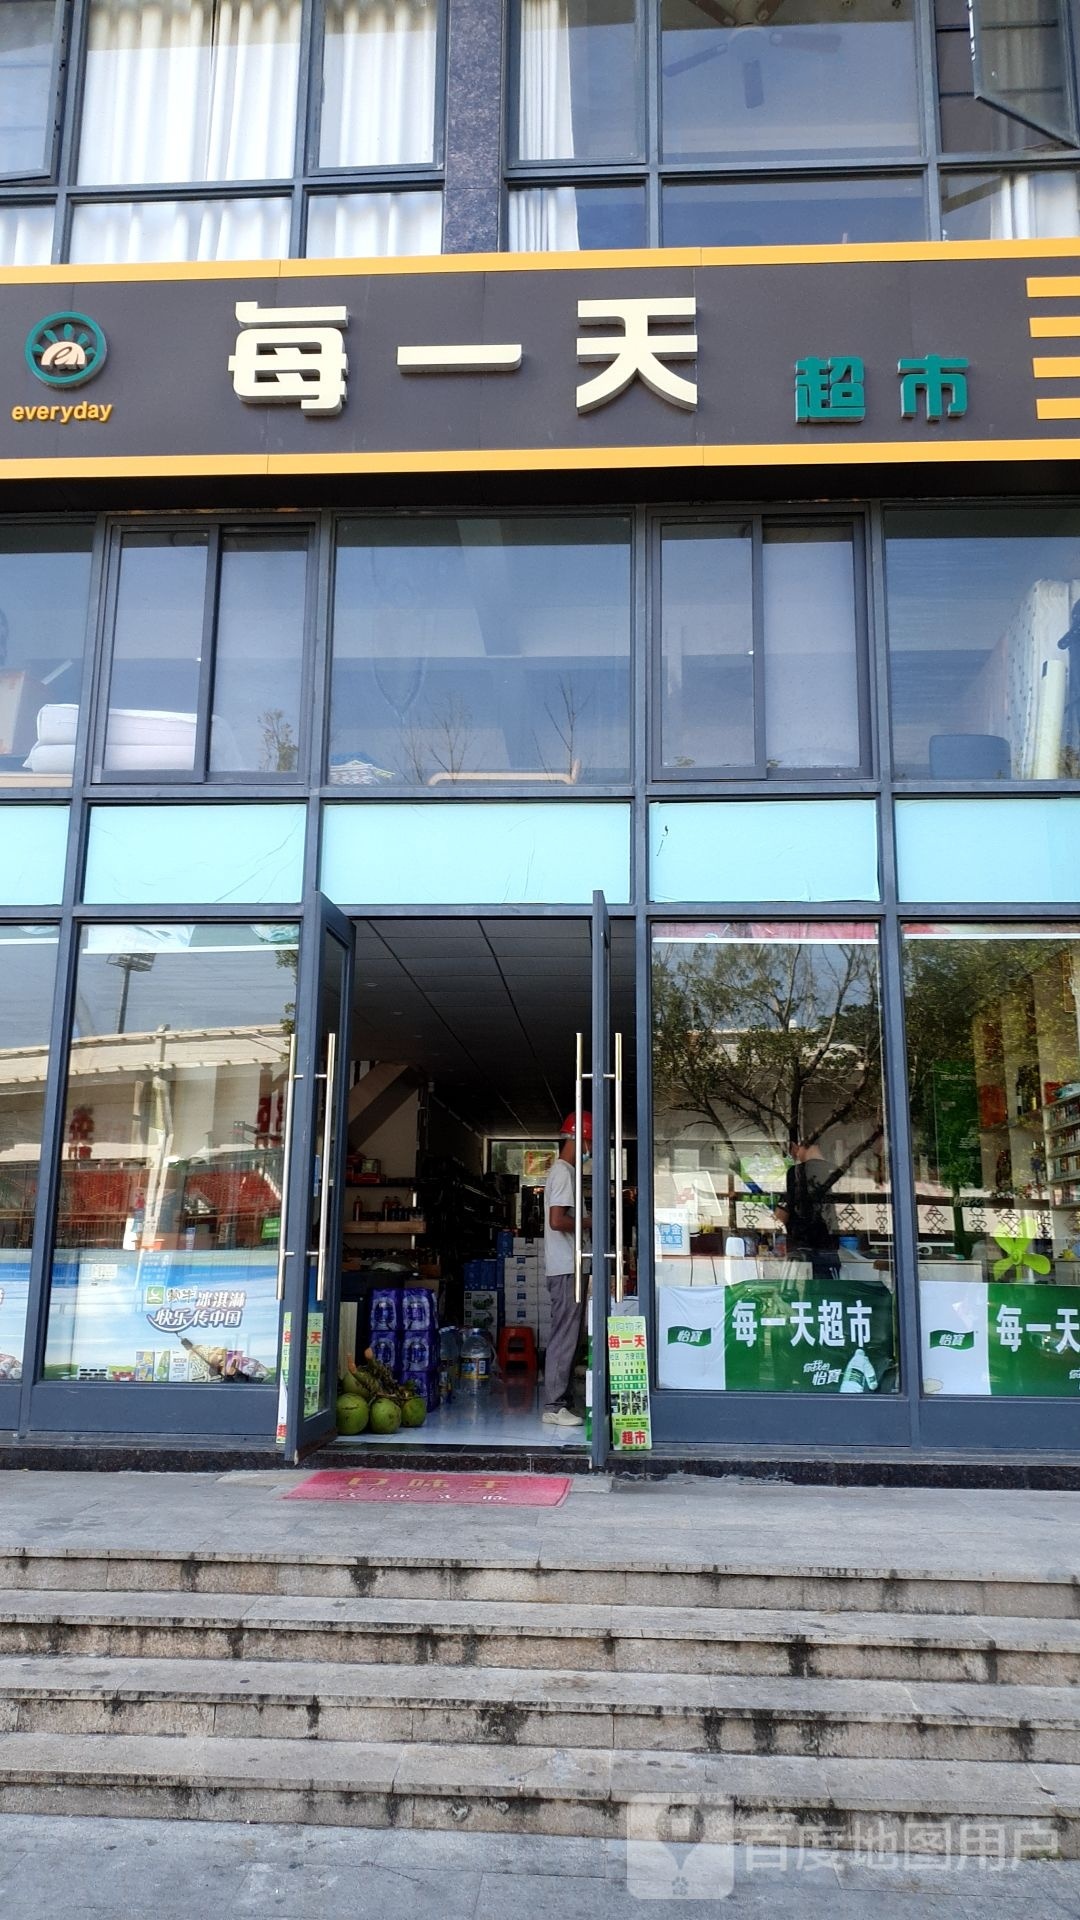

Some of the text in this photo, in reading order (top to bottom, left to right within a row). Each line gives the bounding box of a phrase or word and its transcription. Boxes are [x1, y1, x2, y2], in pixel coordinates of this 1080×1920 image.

[228, 297, 970, 423] 每一天 超市
[11, 400, 113, 423] everyday
[195, 1290, 247, 1308] 冰淇淋
[154, 1308, 243, 1328] 快乐传中国
[732, 1299, 873, 1347] 每一天超市
[996, 1304, 1080, 1353] 每一天
[608, 1334, 645, 1349] 每一天
[622, 1430, 646, 1445] 超市
